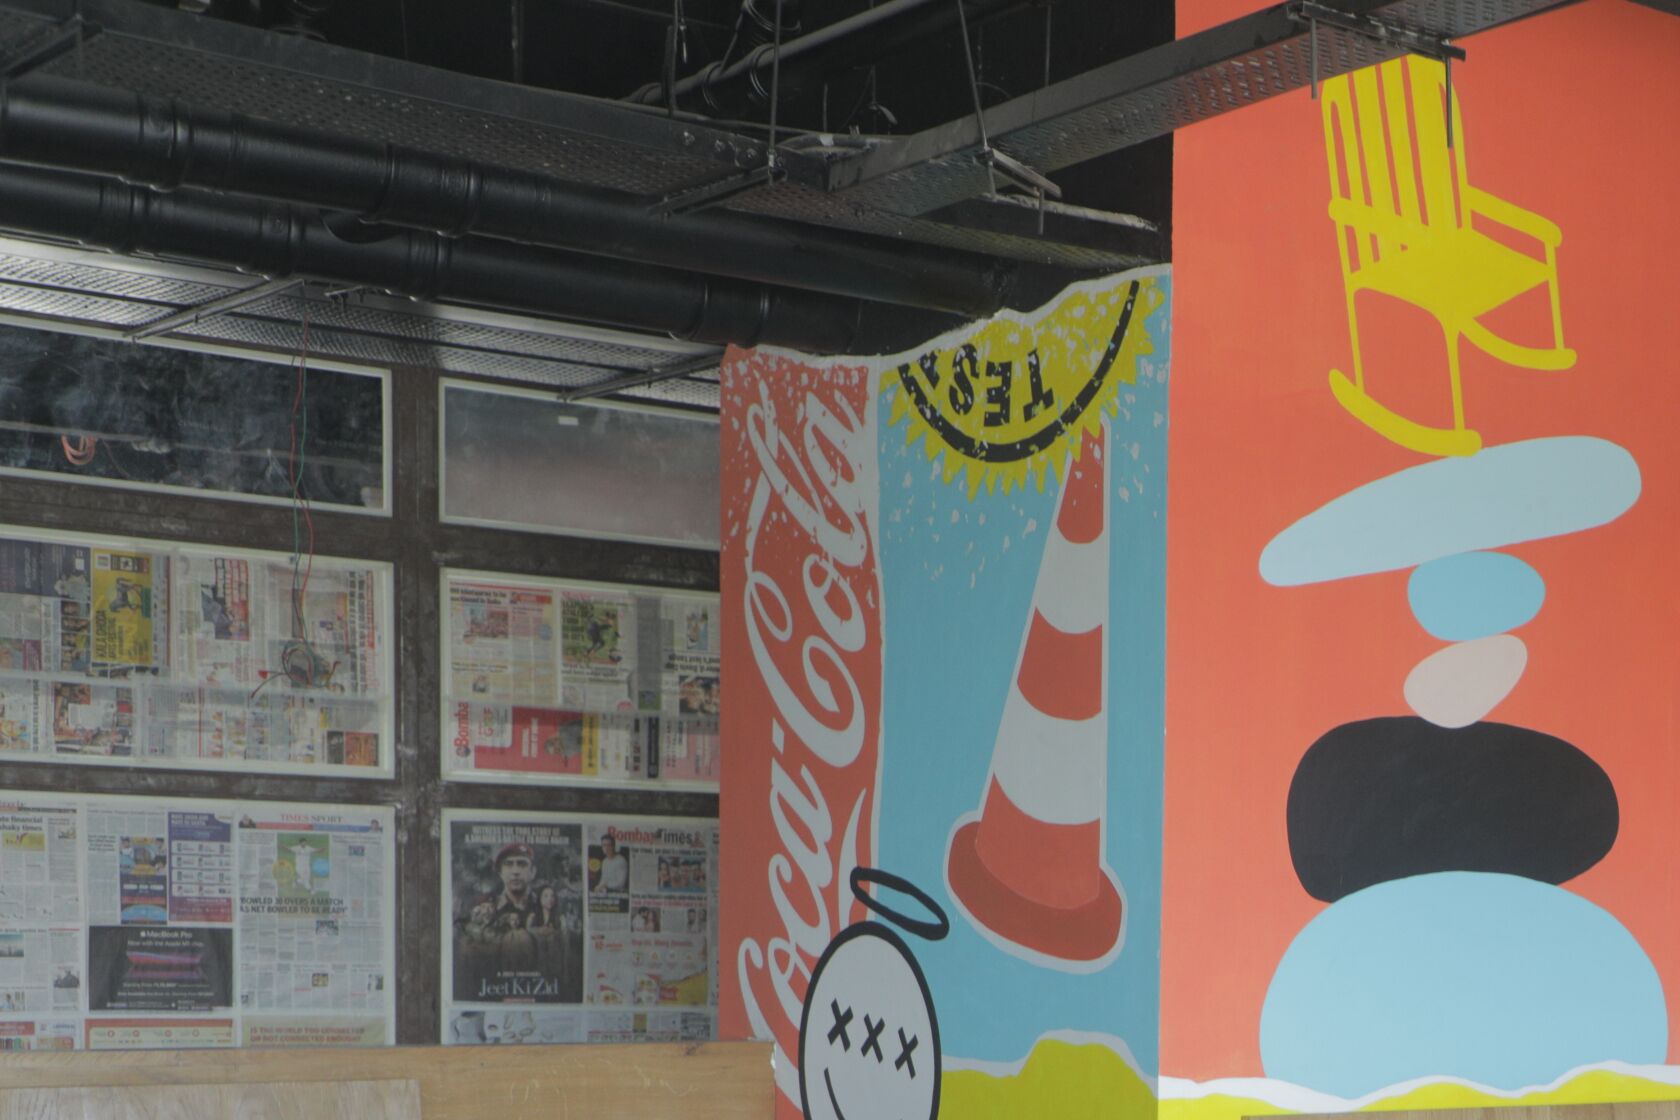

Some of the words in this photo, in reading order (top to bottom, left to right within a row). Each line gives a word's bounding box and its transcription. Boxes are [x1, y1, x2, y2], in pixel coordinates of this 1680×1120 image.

[738, 372, 867, 1112] Coca-Cola
[280, 814, 309, 822] TIMES
[311, 815, 343, 823] SPORT
[607, 826, 656, 845] Bombay
[656, 828, 693, 844] Times
[146, 930, 179, 938] MacBook
[478, 977, 509, 997] Jeet
[512, 977, 531, 995] Ki
[533, 977, 559, 995] Zid
